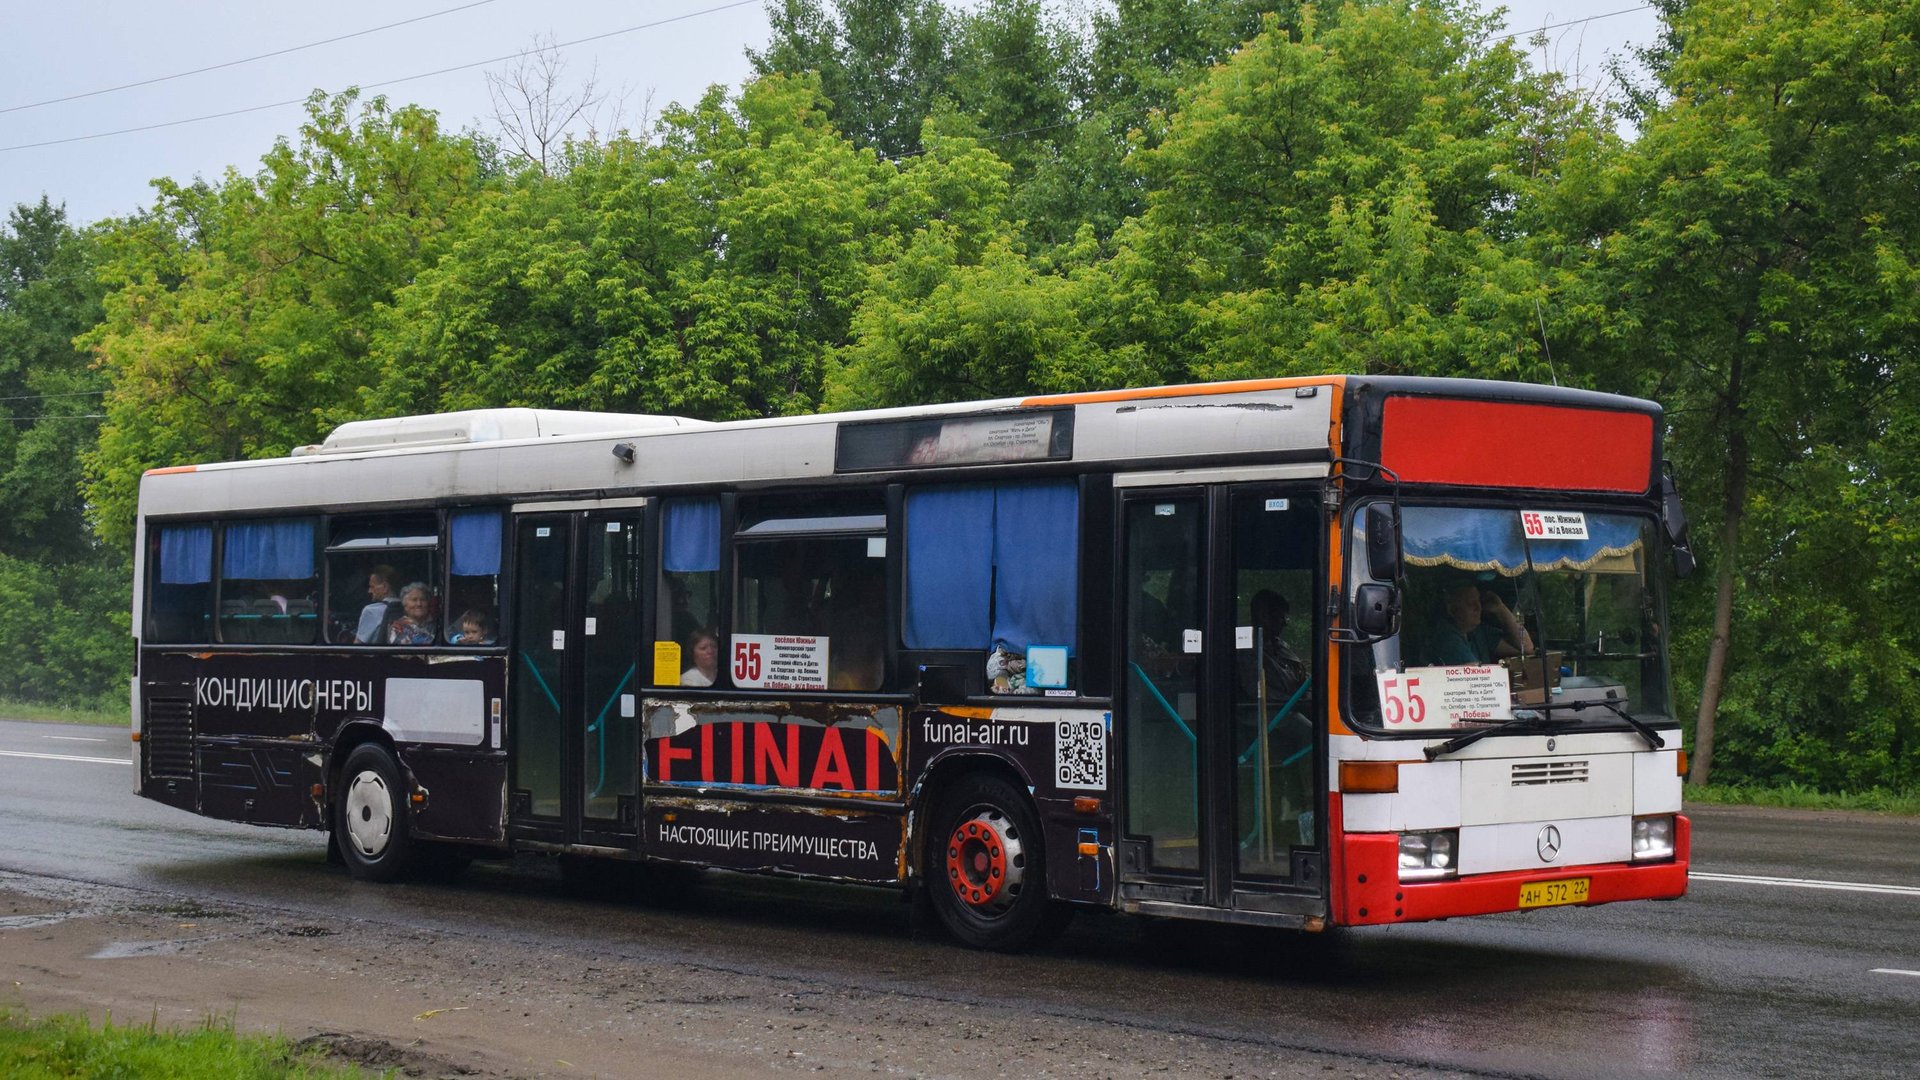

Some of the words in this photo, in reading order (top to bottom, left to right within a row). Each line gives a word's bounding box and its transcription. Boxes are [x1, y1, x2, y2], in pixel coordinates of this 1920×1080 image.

[1523, 513, 1543, 535] 55
[1544, 515, 1557, 524] пос.
[1557, 514, 1582, 524] Южный
[1548, 526, 1561, 535] ж/д
[1561, 526, 1584, 535] Вокзал
[735, 643, 761, 681] 55
[1463, 667, 1491, 675] Южный
[196, 677, 372, 713] КОНДИЦИОНЕРЫ
[1383, 677, 1425, 724] 55
[1463, 710, 1491, 719] Победы
[923, 717, 1029, 745] funai-air.ru
[659, 824, 749, 850] НАСТОЯЩИЕ
[753, 831, 879, 861] ПРЕИМУЩЕСТВА
[1547, 884, 1567, 902] 572
[1574, 881, 1585, 895] 22
